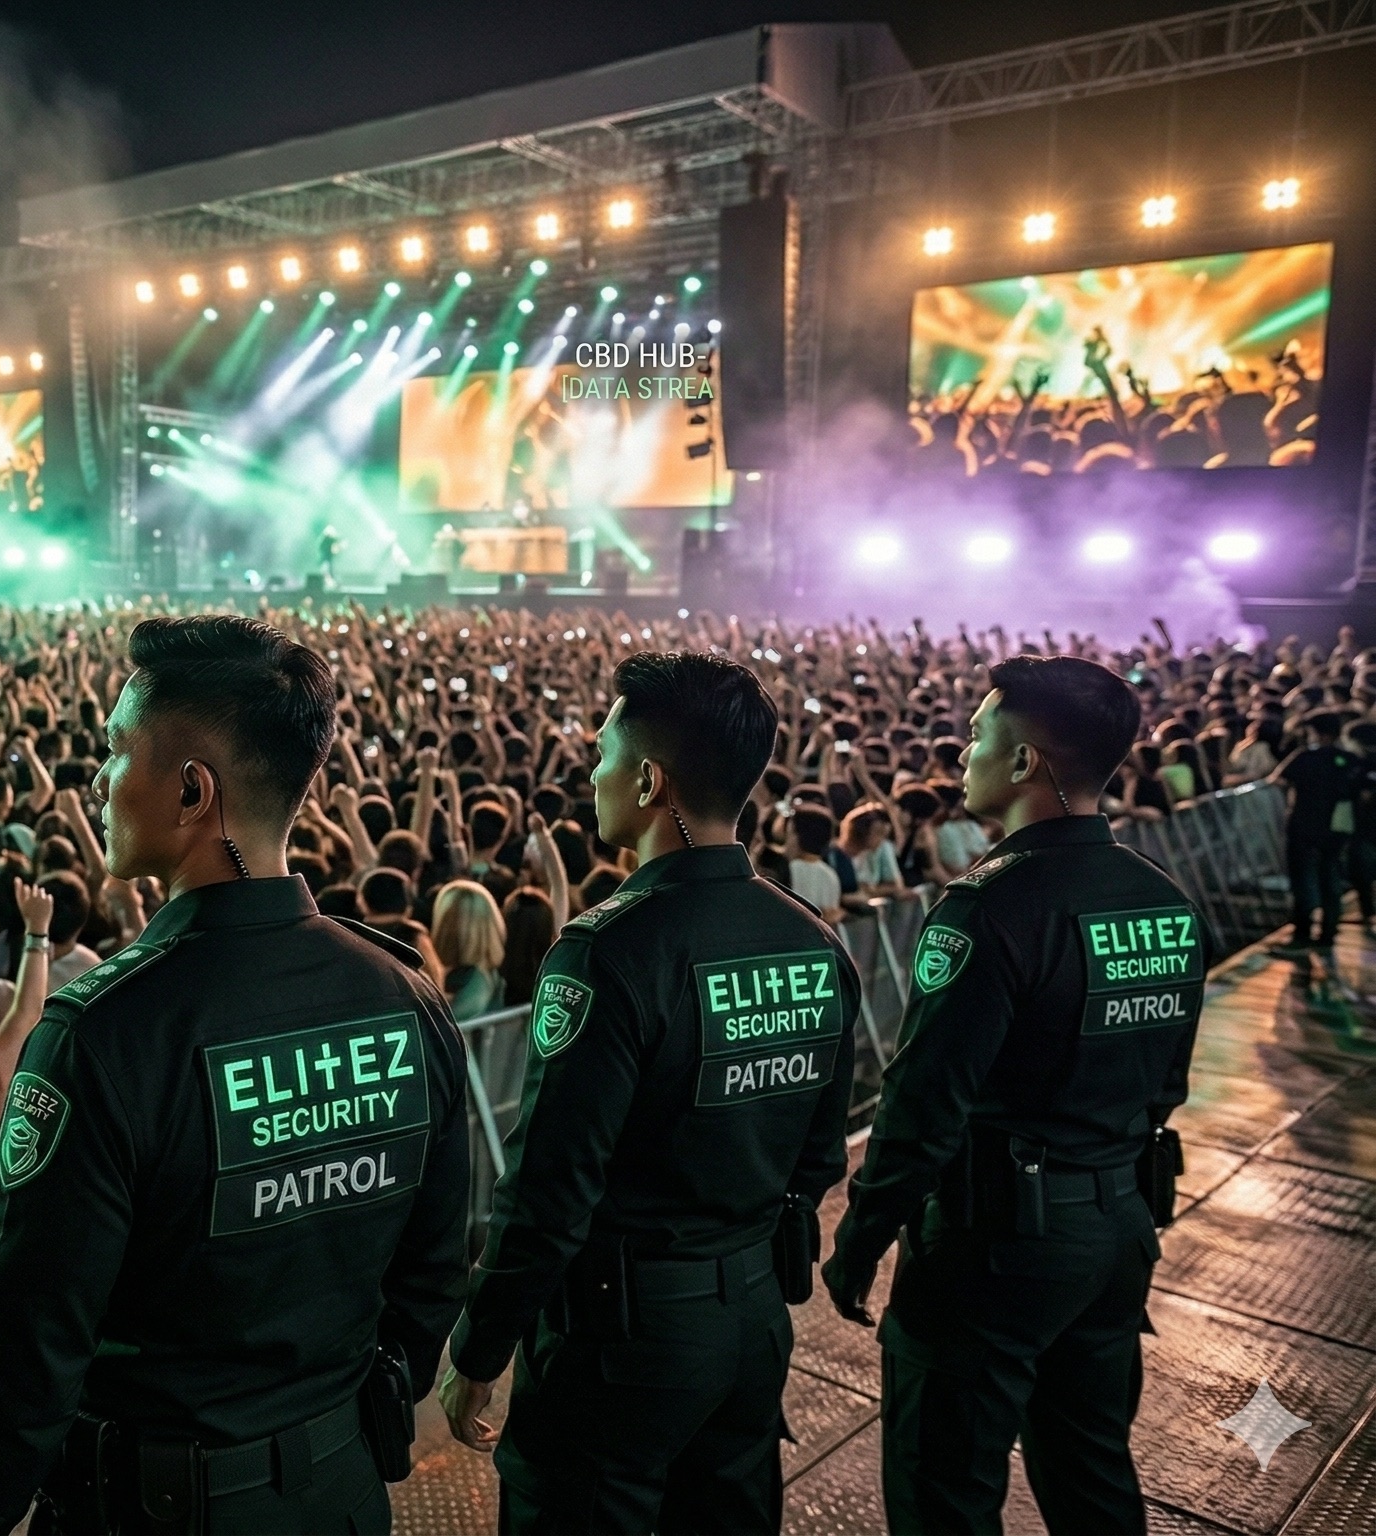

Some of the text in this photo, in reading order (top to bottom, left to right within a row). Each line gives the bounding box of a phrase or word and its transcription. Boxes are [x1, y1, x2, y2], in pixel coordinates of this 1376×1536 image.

[1106, 953, 1189, 981] SECURITY
[725, 1006, 825, 1041] SECURITY
[1104, 992, 1186, 1026] PATROL
[724, 1051, 820, 1096] PATROL
[252, 1088, 399, 1147] SECURITY
[254, 1151, 396, 1218] PATROL
